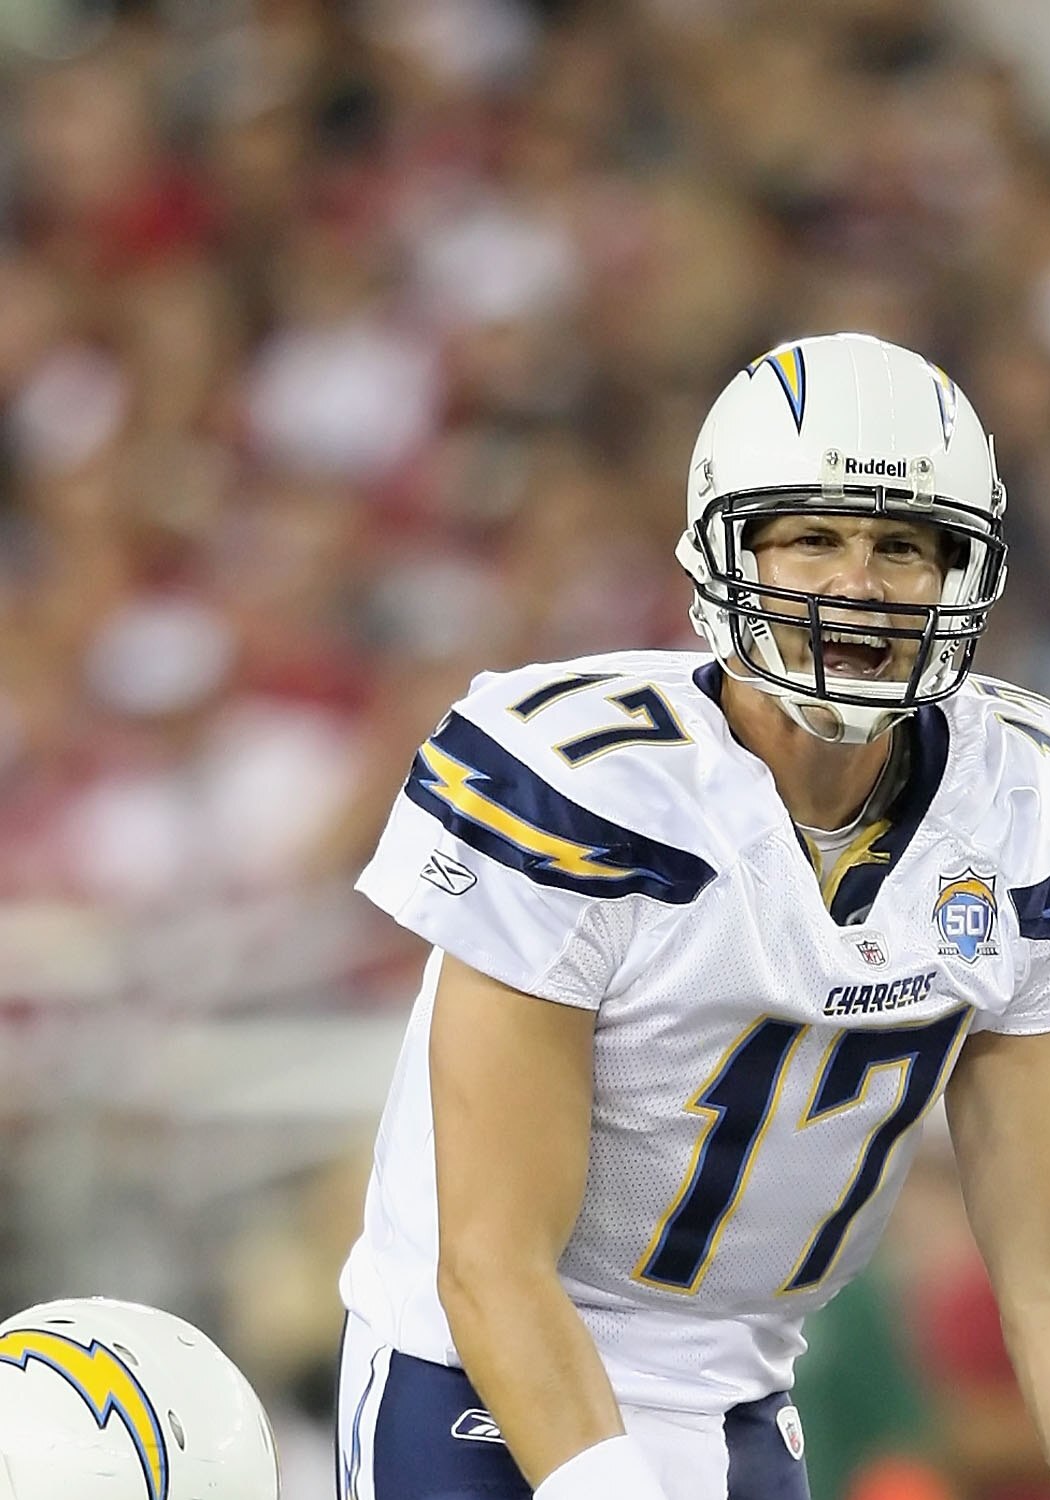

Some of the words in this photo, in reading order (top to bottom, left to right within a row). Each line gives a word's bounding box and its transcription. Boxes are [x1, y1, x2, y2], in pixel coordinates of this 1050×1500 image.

[845, 457, 907, 478] Riddell
[506, 672, 695, 769] 17
[946, 904, 984, 935] 50
[823, 971, 937, 1015] CHARGERS
[629, 1001, 974, 1295] 17
